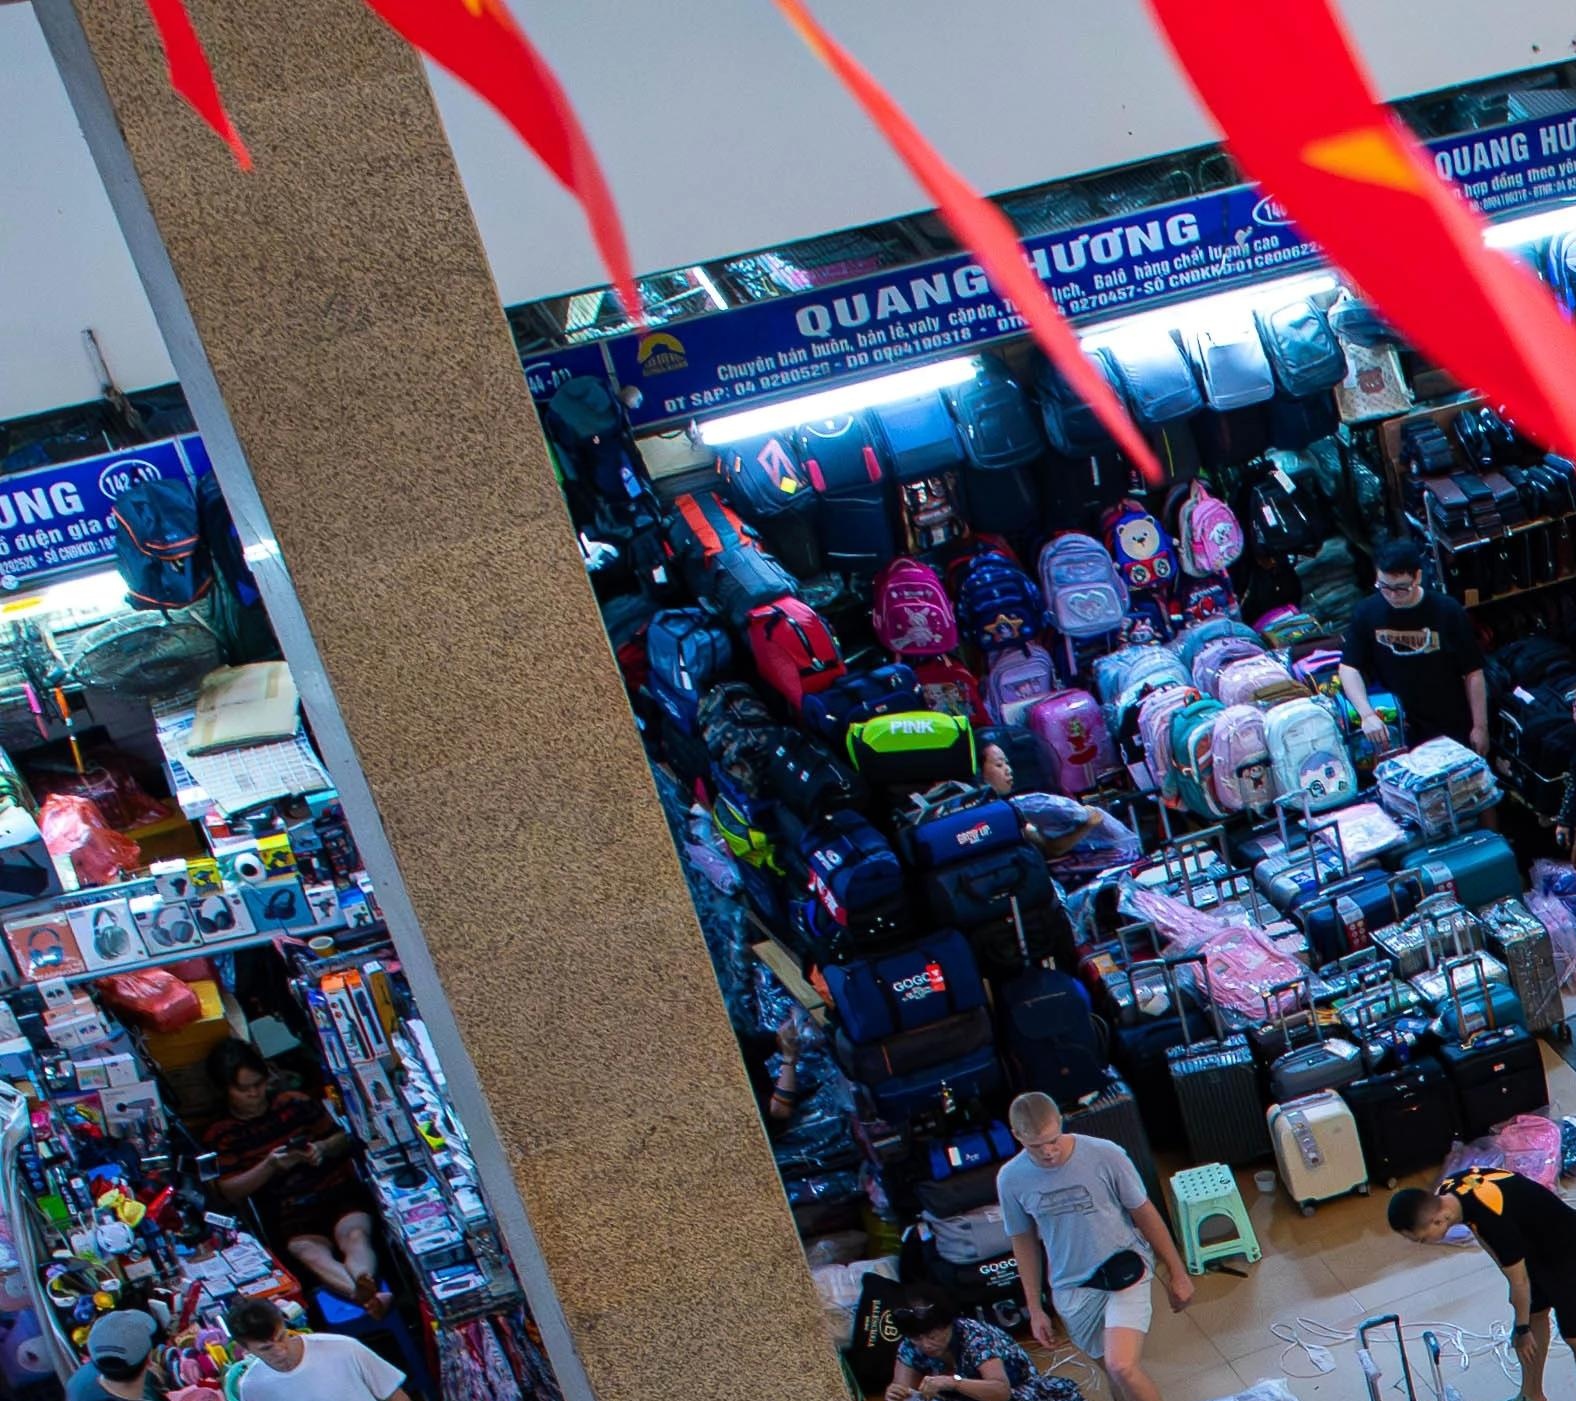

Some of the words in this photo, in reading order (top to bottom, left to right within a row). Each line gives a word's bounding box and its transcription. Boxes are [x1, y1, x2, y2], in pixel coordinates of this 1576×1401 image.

[1435, 127, 1529, 181] QUANG
[717, 349, 775, 382] Chuyên
[1095, 268, 1128, 291] Balô
[1135, 256, 1170, 280] hàng
[1253, 234, 1280, 254] cao
[796, 265, 989, 336] QUANG
[890, 720, 935, 735] PINK
